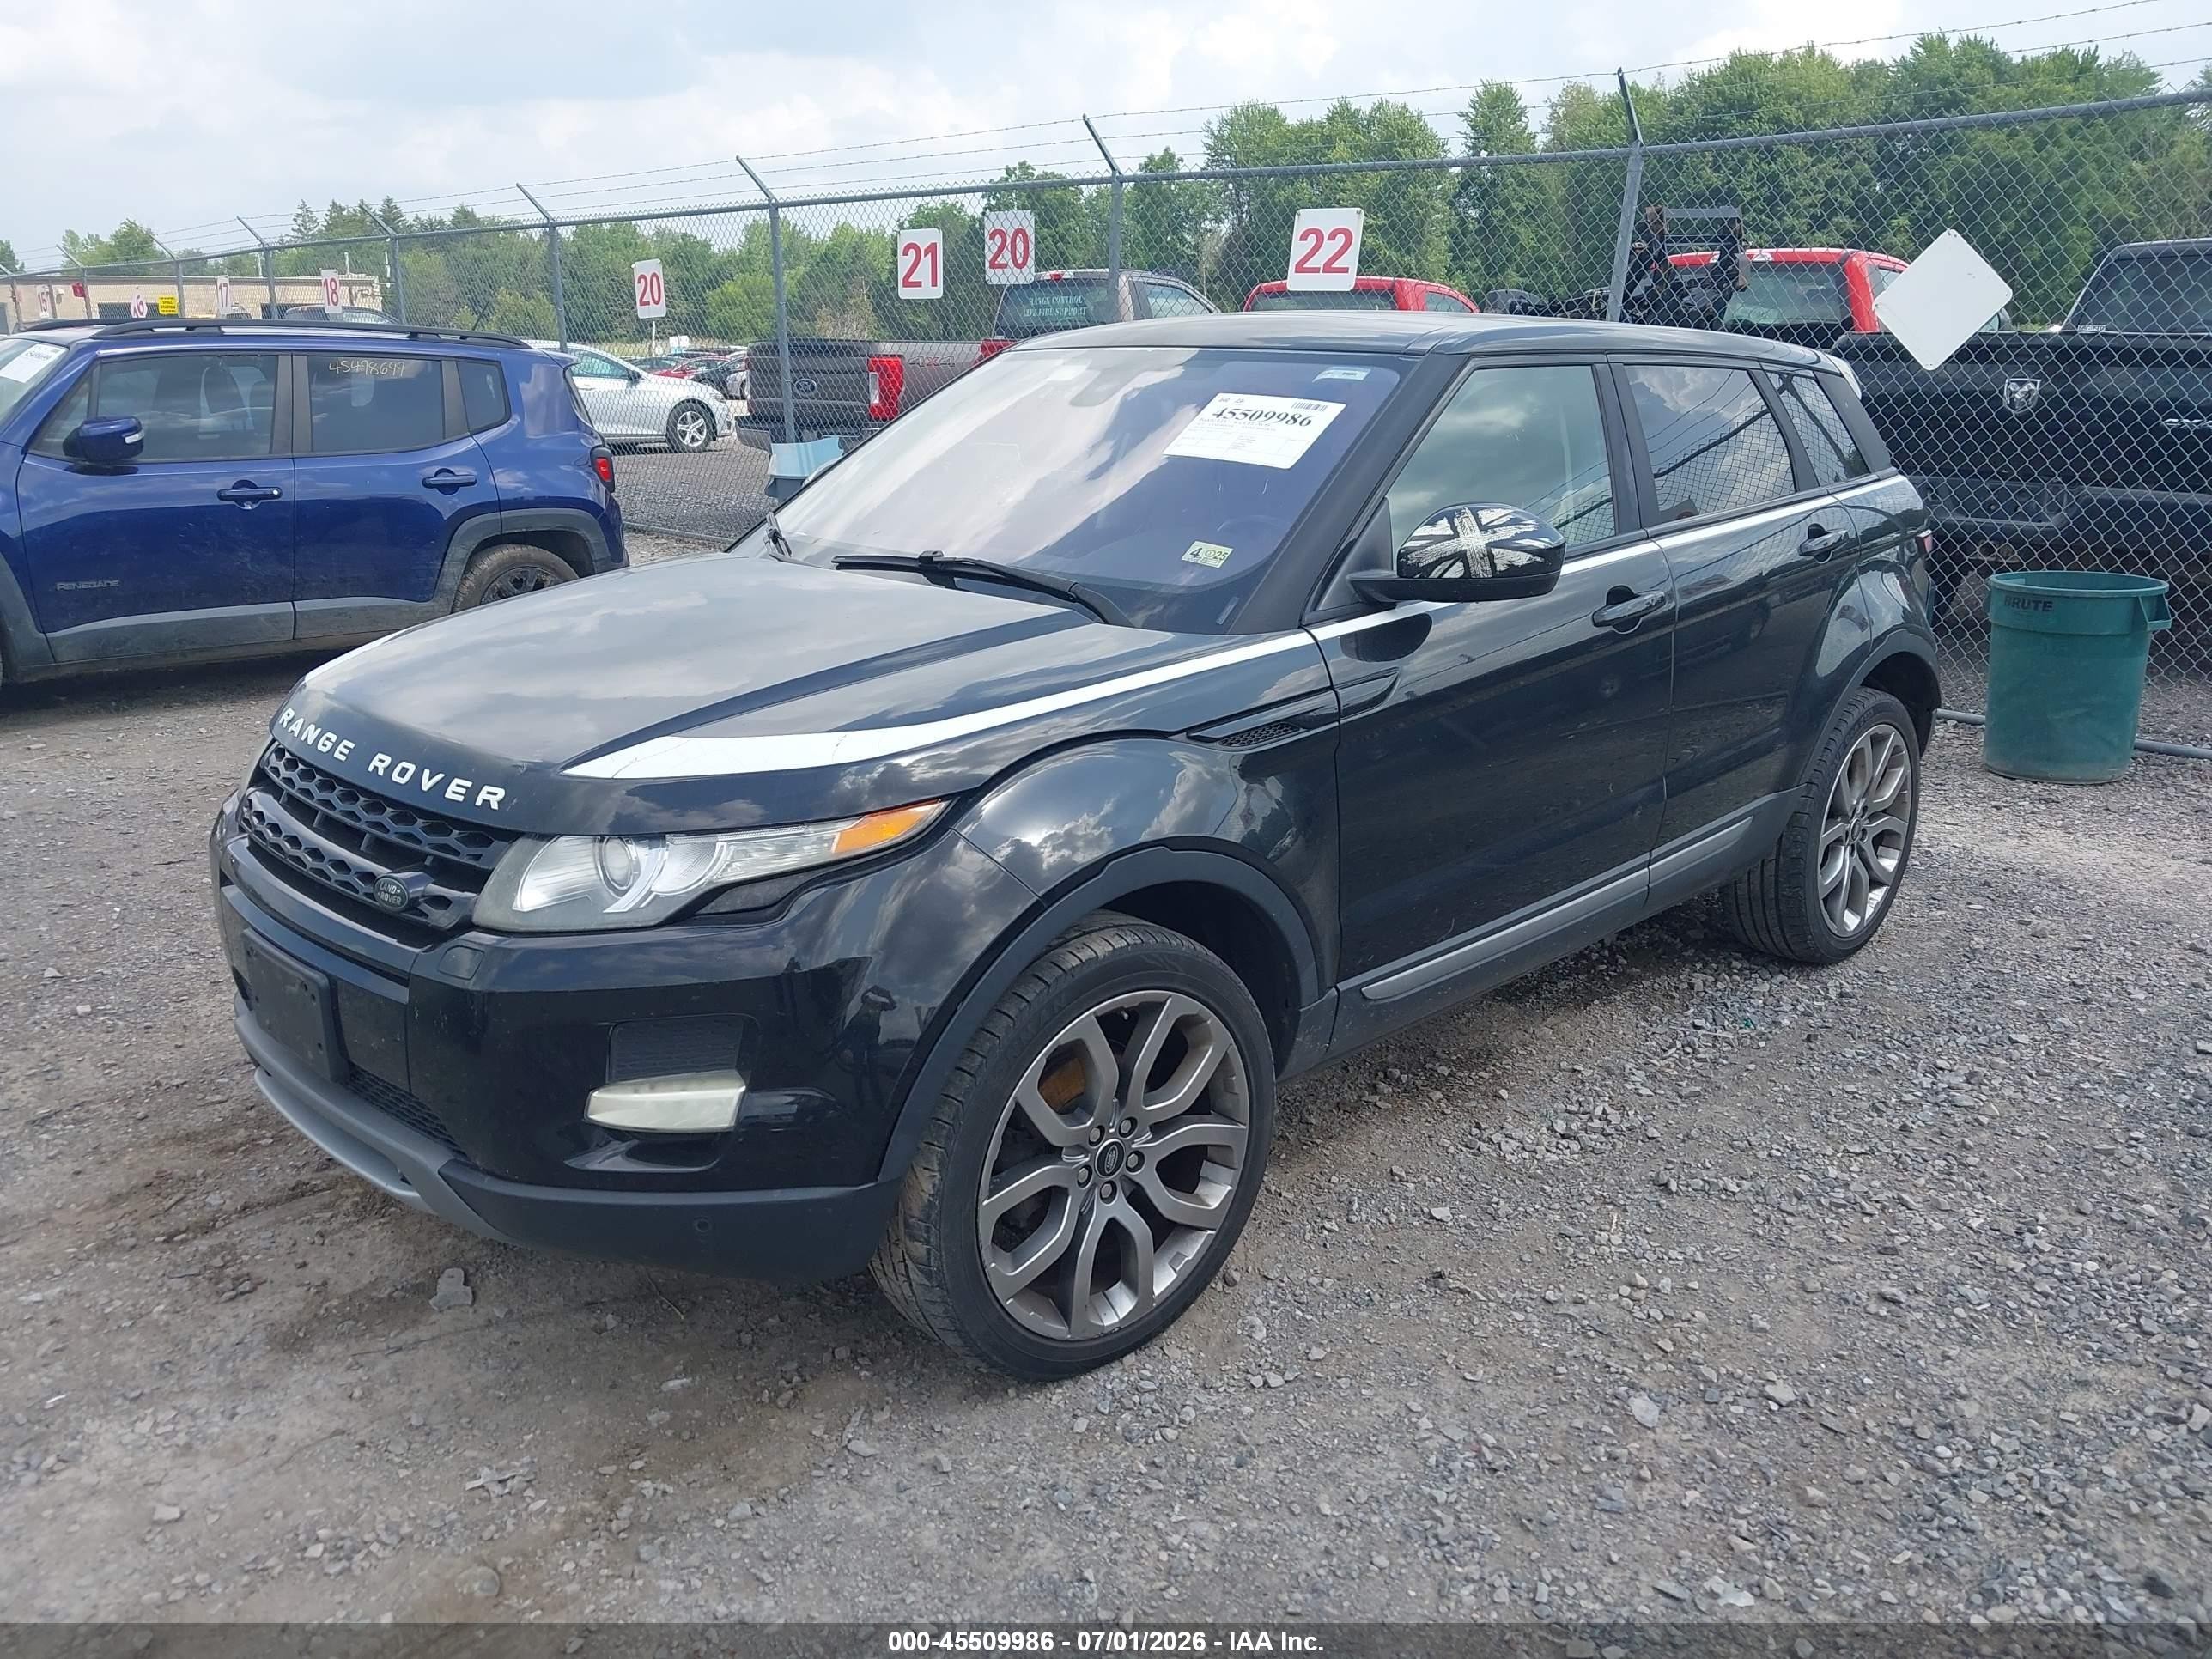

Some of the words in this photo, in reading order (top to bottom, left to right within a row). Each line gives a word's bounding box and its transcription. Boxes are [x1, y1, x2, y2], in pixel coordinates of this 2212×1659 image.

[988, 228, 1030, 270] 20
[1294, 227, 1354, 274] 22
[902, 242, 939, 289] 21
[218, 283, 228, 307] 17
[323, 277, 340, 307] 18
[637, 272, 662, 307] 20
[1212, 406, 1319, 428] 45509986
[1189, 547, 1203, 558] 4
[56, 580, 120, 591] RENEGADE
[2003, 594, 2054, 612] BRUTE
[278, 707, 356, 762] RANGE
[368, 751, 506, 811] ROVER
